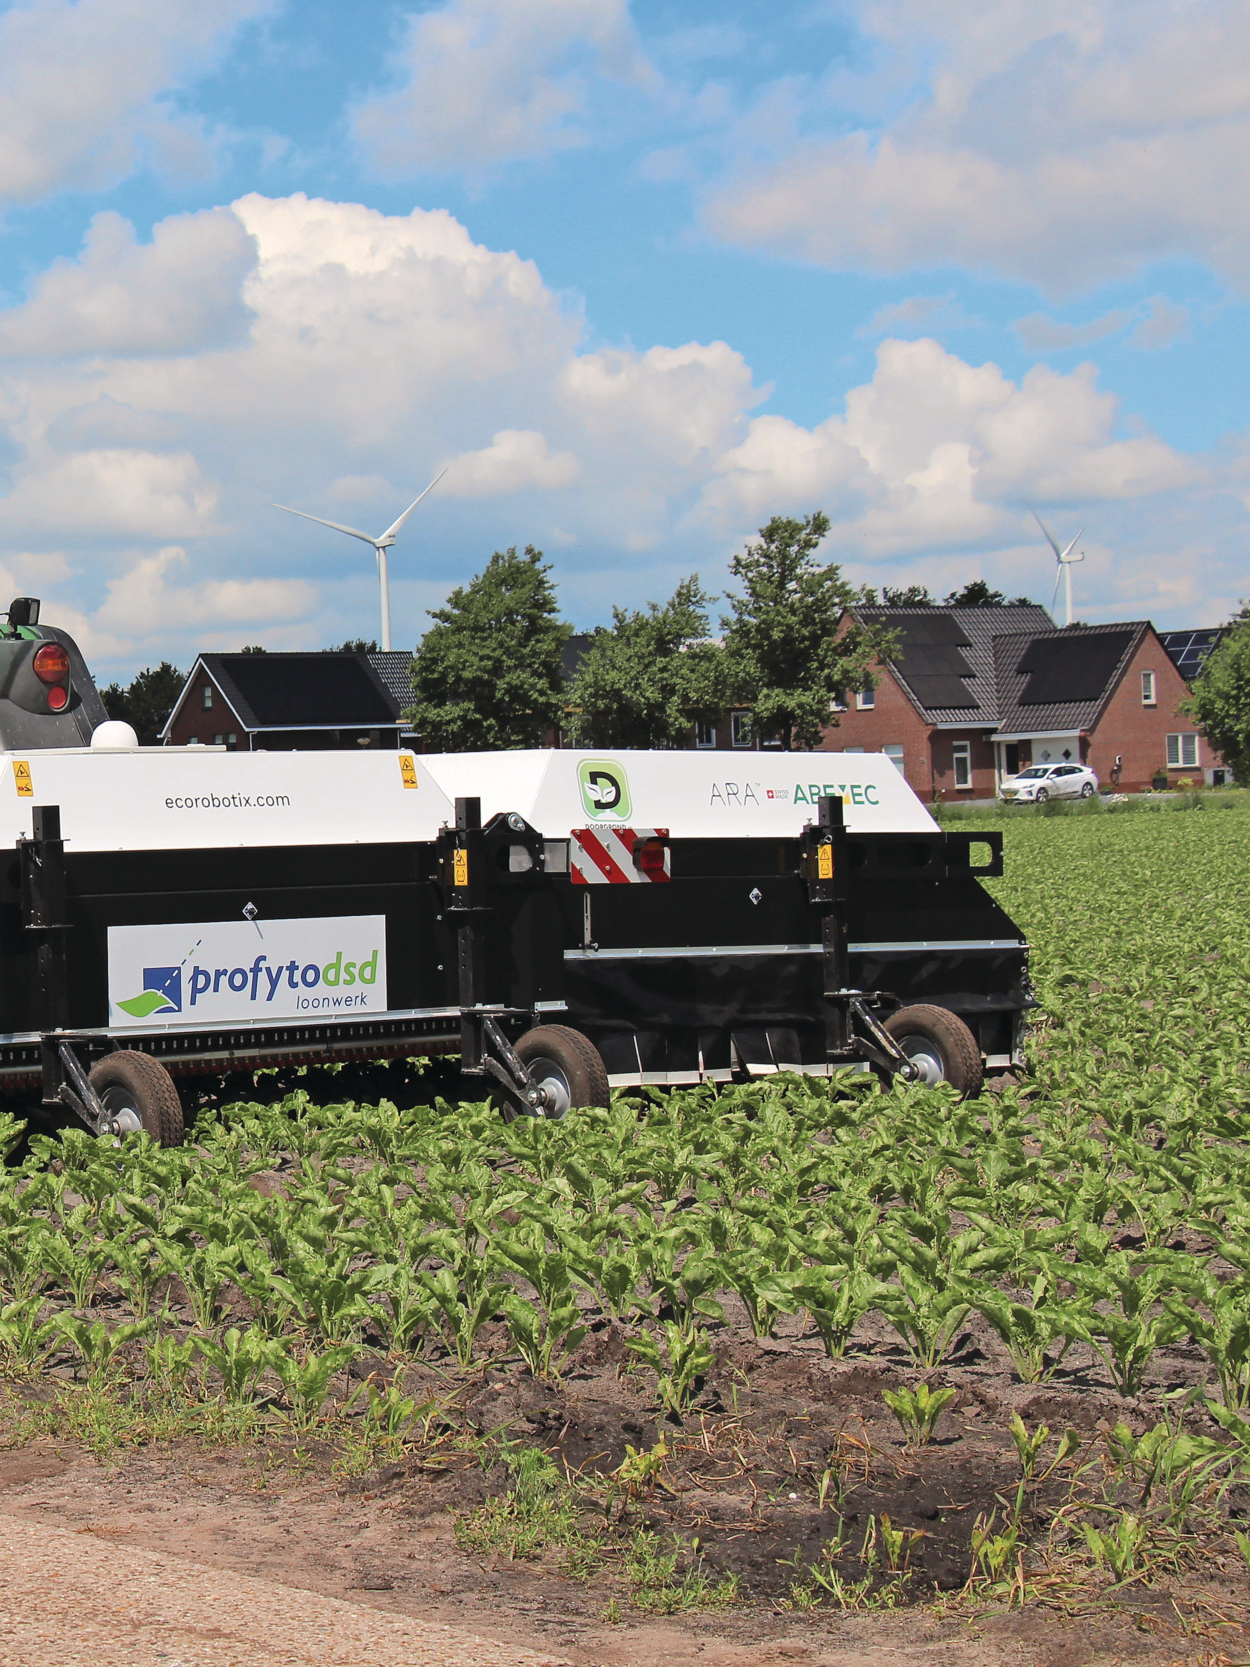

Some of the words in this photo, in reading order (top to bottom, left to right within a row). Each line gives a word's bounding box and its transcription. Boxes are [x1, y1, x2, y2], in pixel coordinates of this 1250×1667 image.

[164, 792, 291, 809] ecorobotix.com
[187, 949, 379, 1006] profytodsd
[296, 992, 368, 1010] loonwerk
